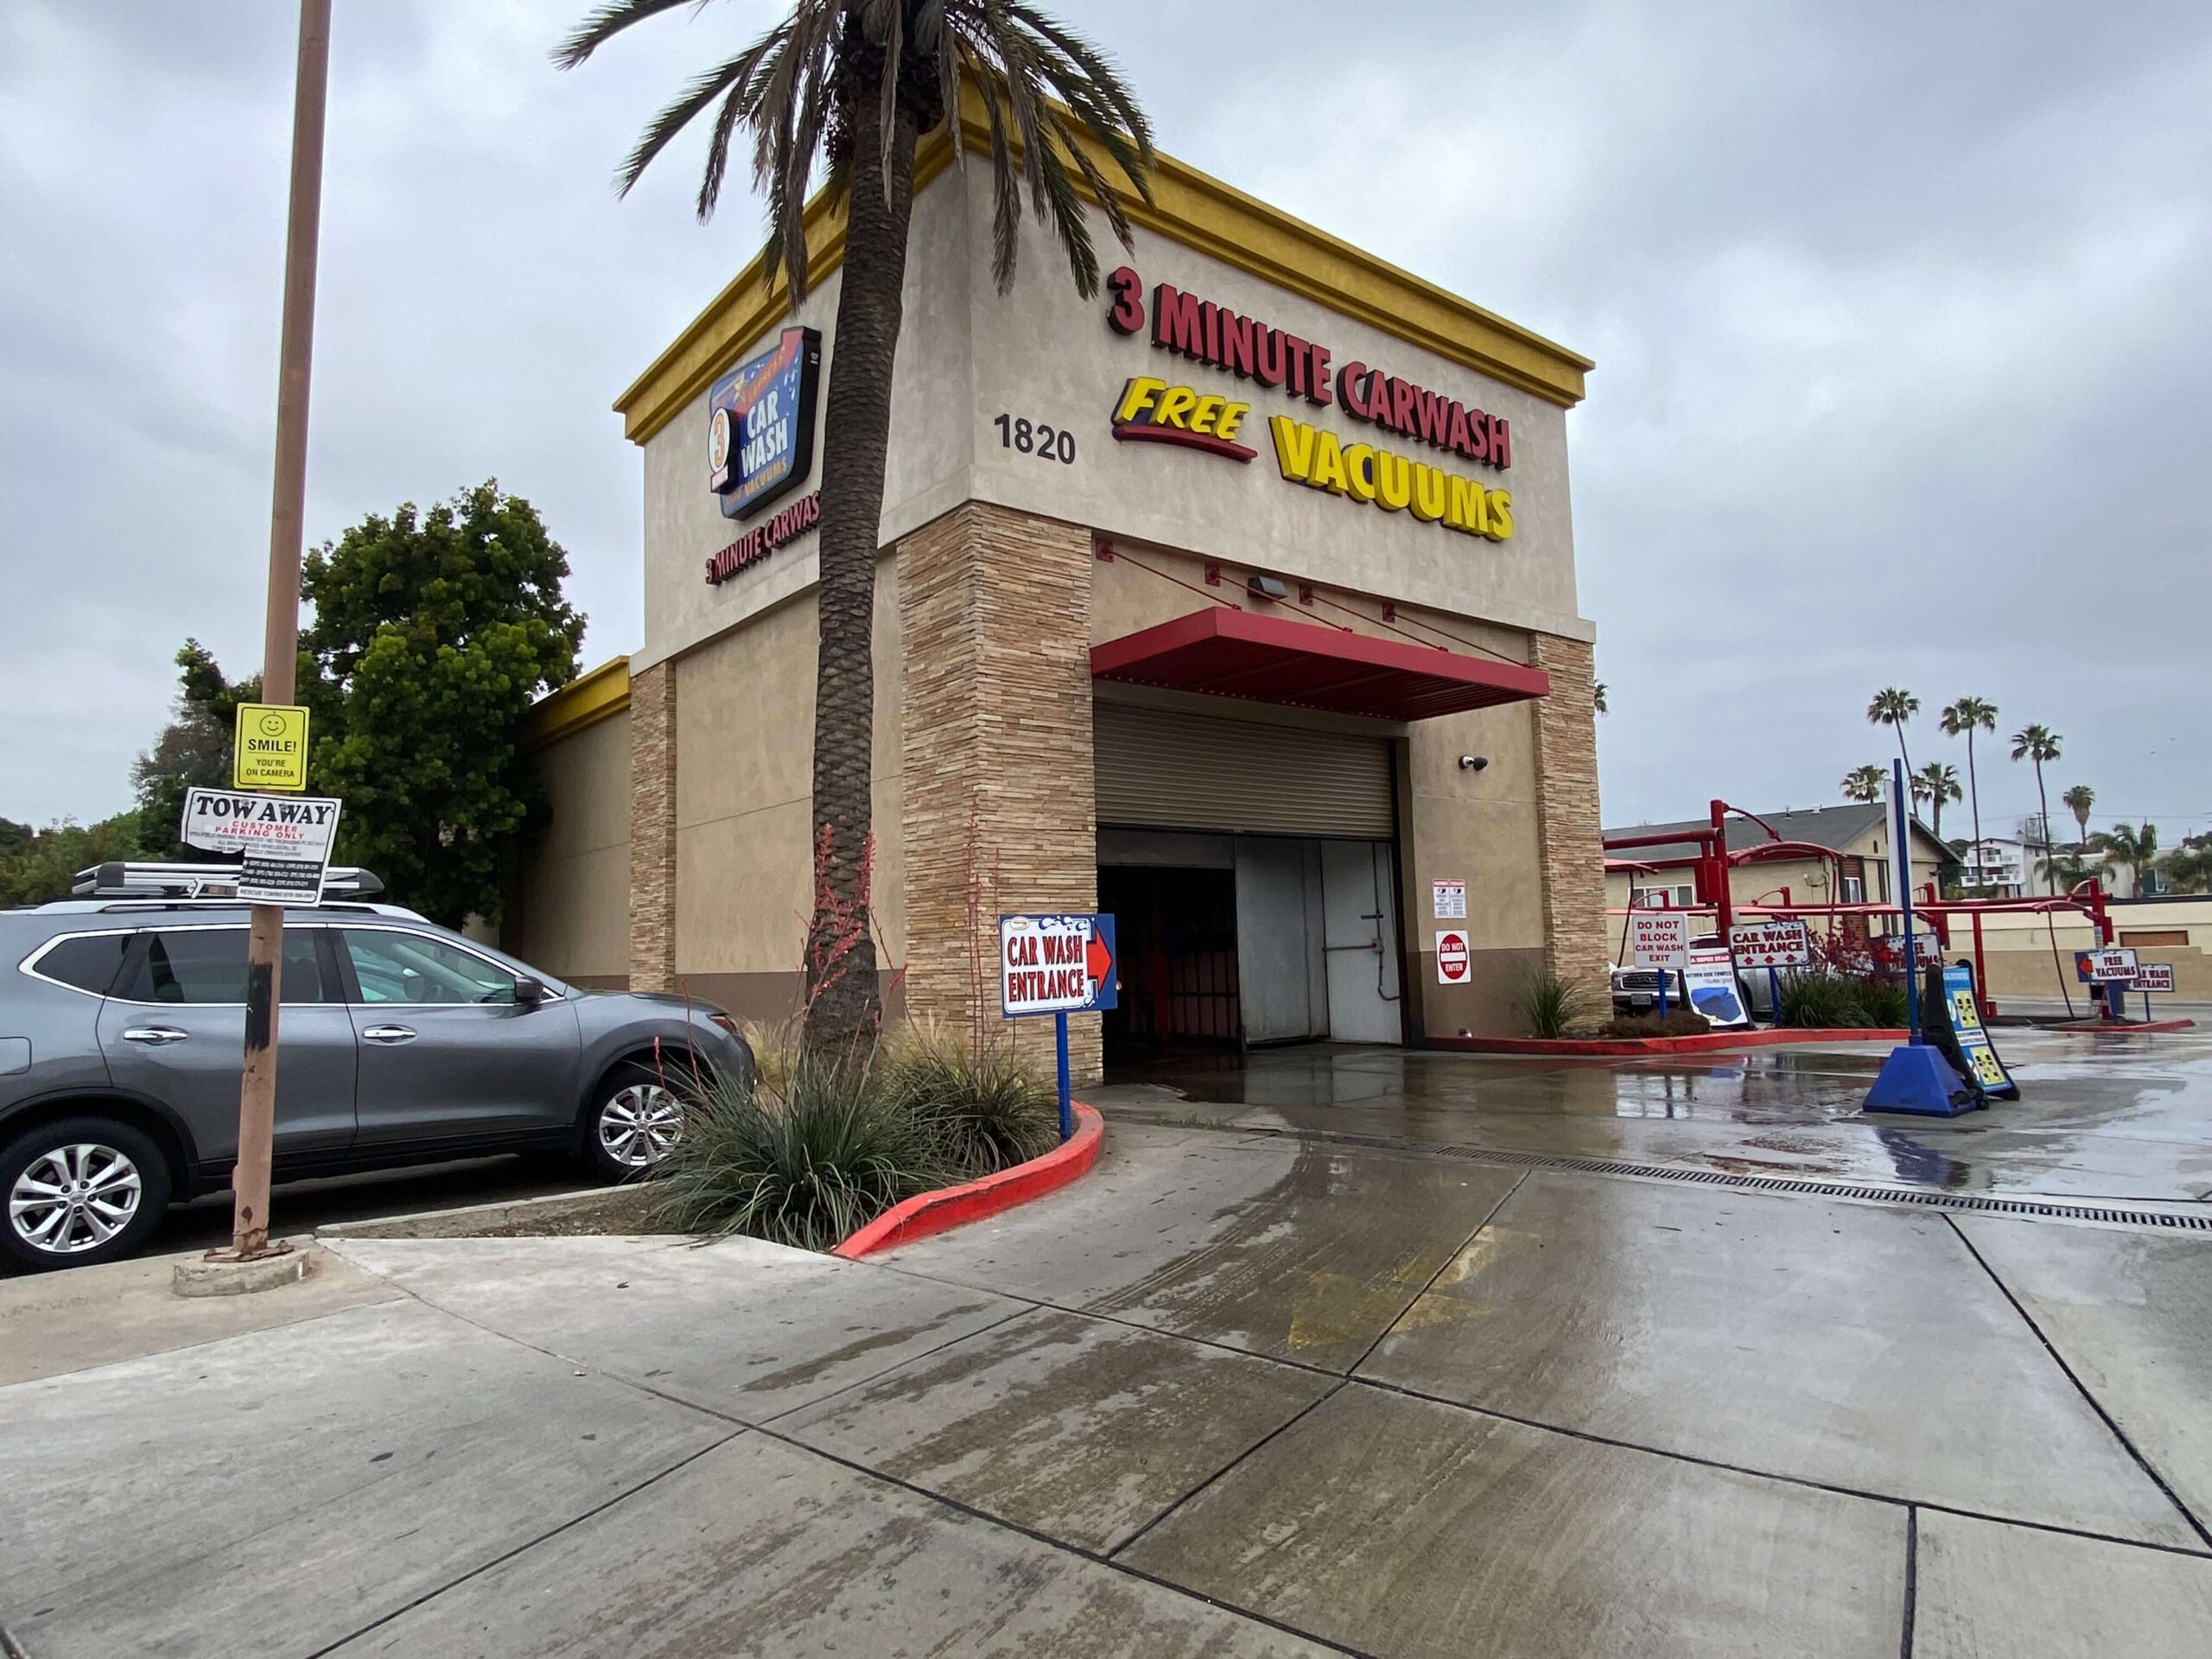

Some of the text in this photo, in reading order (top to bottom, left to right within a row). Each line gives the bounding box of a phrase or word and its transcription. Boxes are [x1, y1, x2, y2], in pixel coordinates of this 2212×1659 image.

[1107, 265, 1510, 471] 3 MINUTE CARWASH
[747, 391, 779, 439] CAR
[1115, 376, 1251, 441] FREE
[714, 412, 725, 467] 3
[995, 413, 1076, 464] 1820
[741, 417, 788, 478] WASH
[1268, 415, 1513, 542] VACUUMS
[705, 490, 821, 585] 3 MINUTE CARWAS
[248, 739, 296, 753] SMILE!
[257, 759, 286, 767] YOU'RE
[260, 768, 295, 778] CAMERA
[197, 796, 332, 825] TOW AWAY
[215, 826, 304, 840] PARKING ONLY
[232, 821, 298, 833] CUSTOMER
[1637, 920, 1680, 930] DO NOT
[1640, 933, 1677, 942] BLOCK
[1732, 930, 1802, 944] CAR WASH
[1007, 935, 1084, 967] CAR WASH
[1441, 943, 1464, 951] DO NOT
[1733, 941, 1804, 956] ENTRANCE
[1446, 963, 1464, 972] ENTER
[2104, 957, 2123, 966] FREE
[2095, 966, 2135, 977] VACUUMS
[2148, 969, 2170, 978] WASH
[1008, 969, 1084, 1002] ENTRANCE
